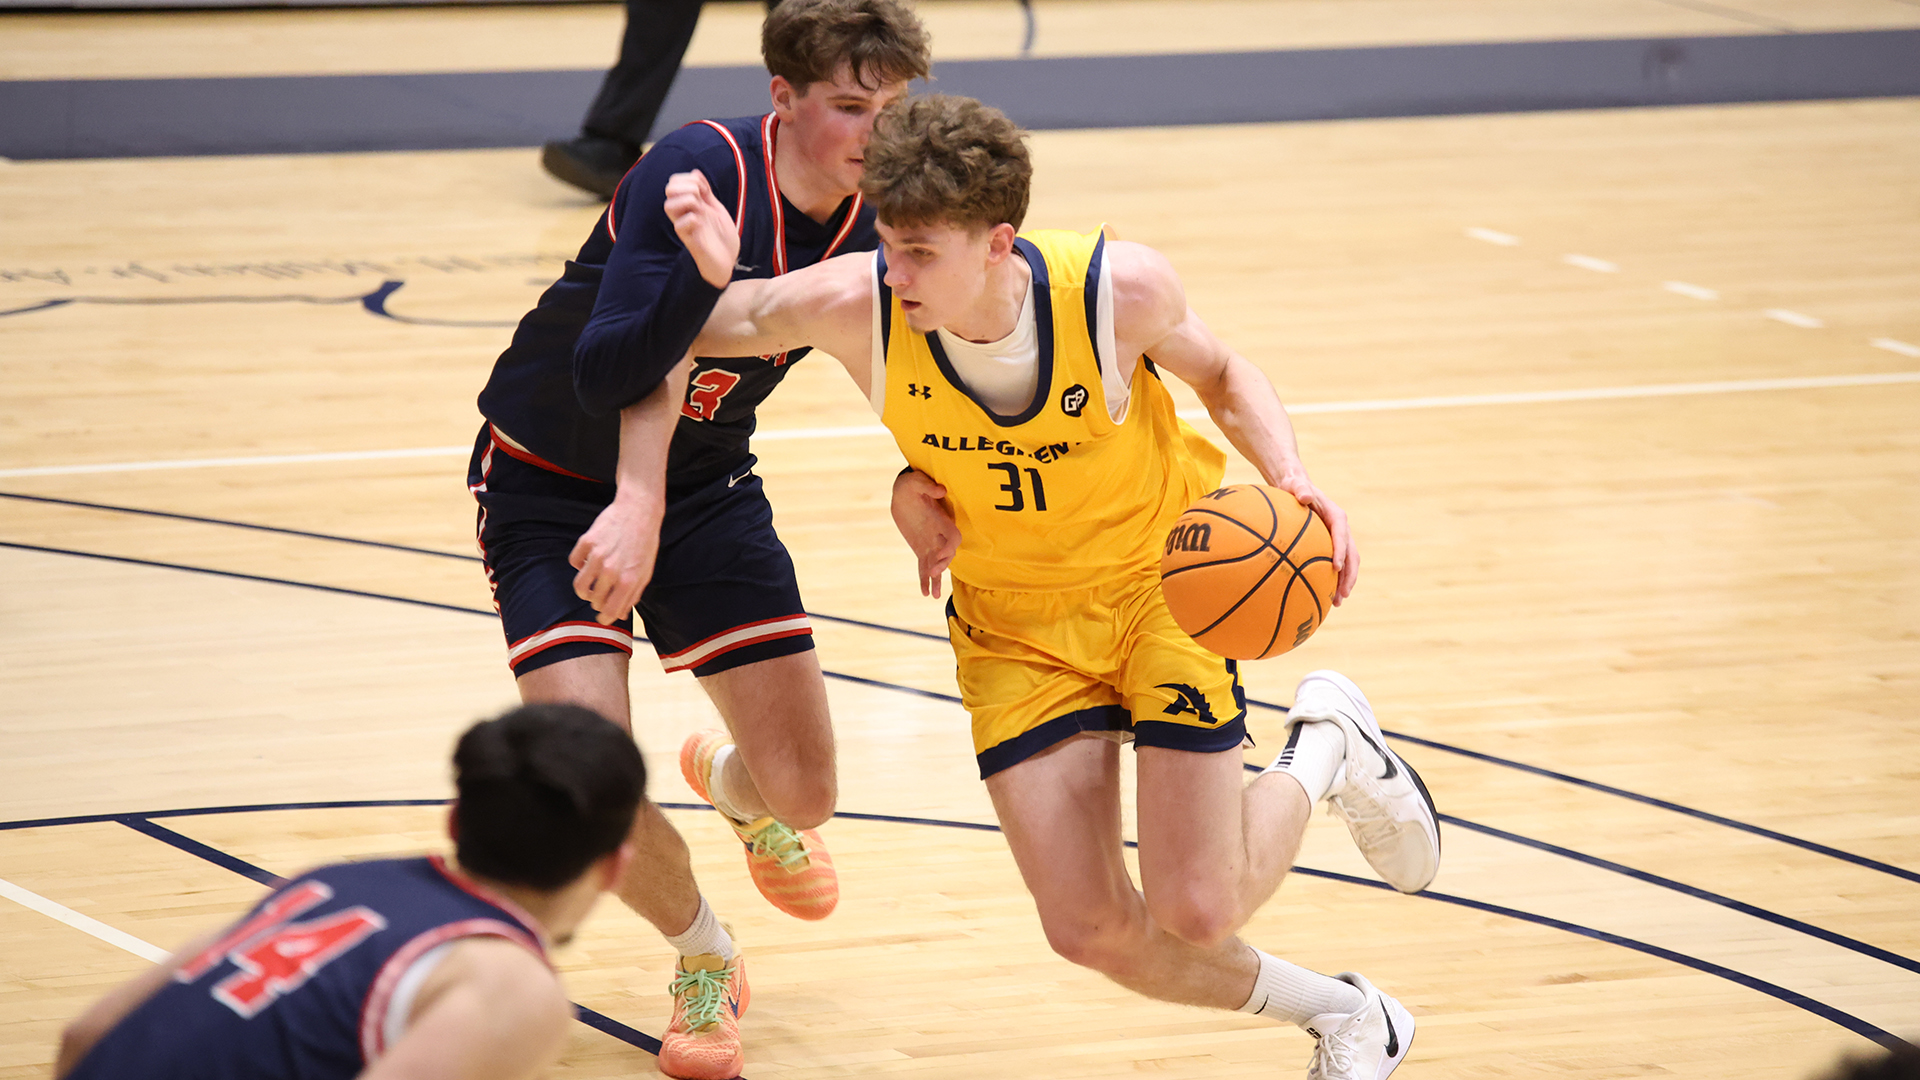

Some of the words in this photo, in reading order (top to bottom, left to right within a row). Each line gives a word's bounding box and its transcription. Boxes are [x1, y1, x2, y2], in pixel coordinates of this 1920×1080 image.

[922, 433, 1082, 464] ALLEGEN
[987, 462, 1047, 512] 31
[174, 879, 388, 1020] 14
